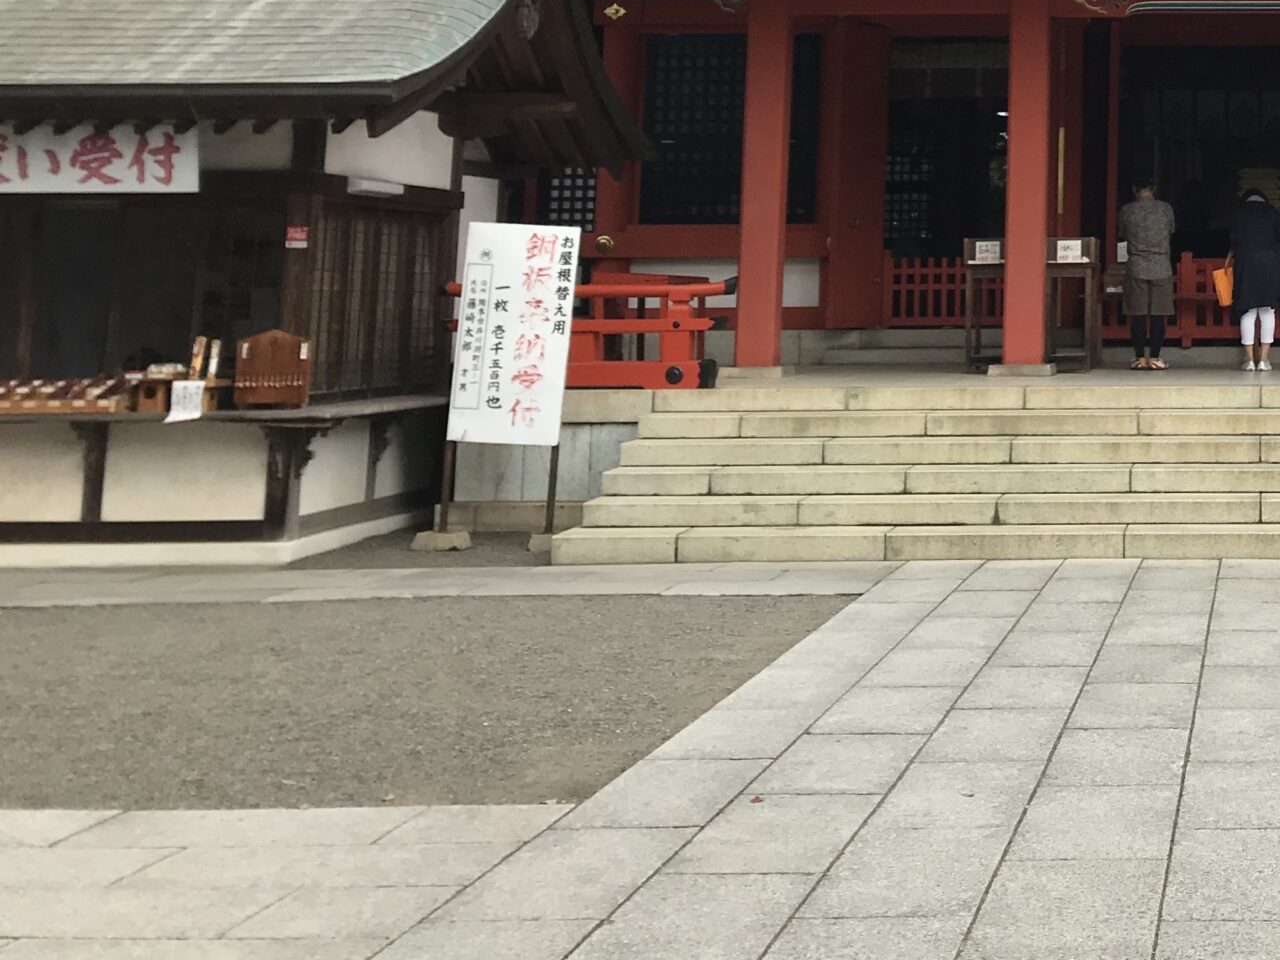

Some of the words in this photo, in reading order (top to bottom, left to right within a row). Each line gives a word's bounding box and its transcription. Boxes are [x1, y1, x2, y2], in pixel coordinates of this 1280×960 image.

[0, 132, 180, 186] い受付
[493, 284, 511, 313] 一枚
[551, 236, 575, 336] お屋根替え用
